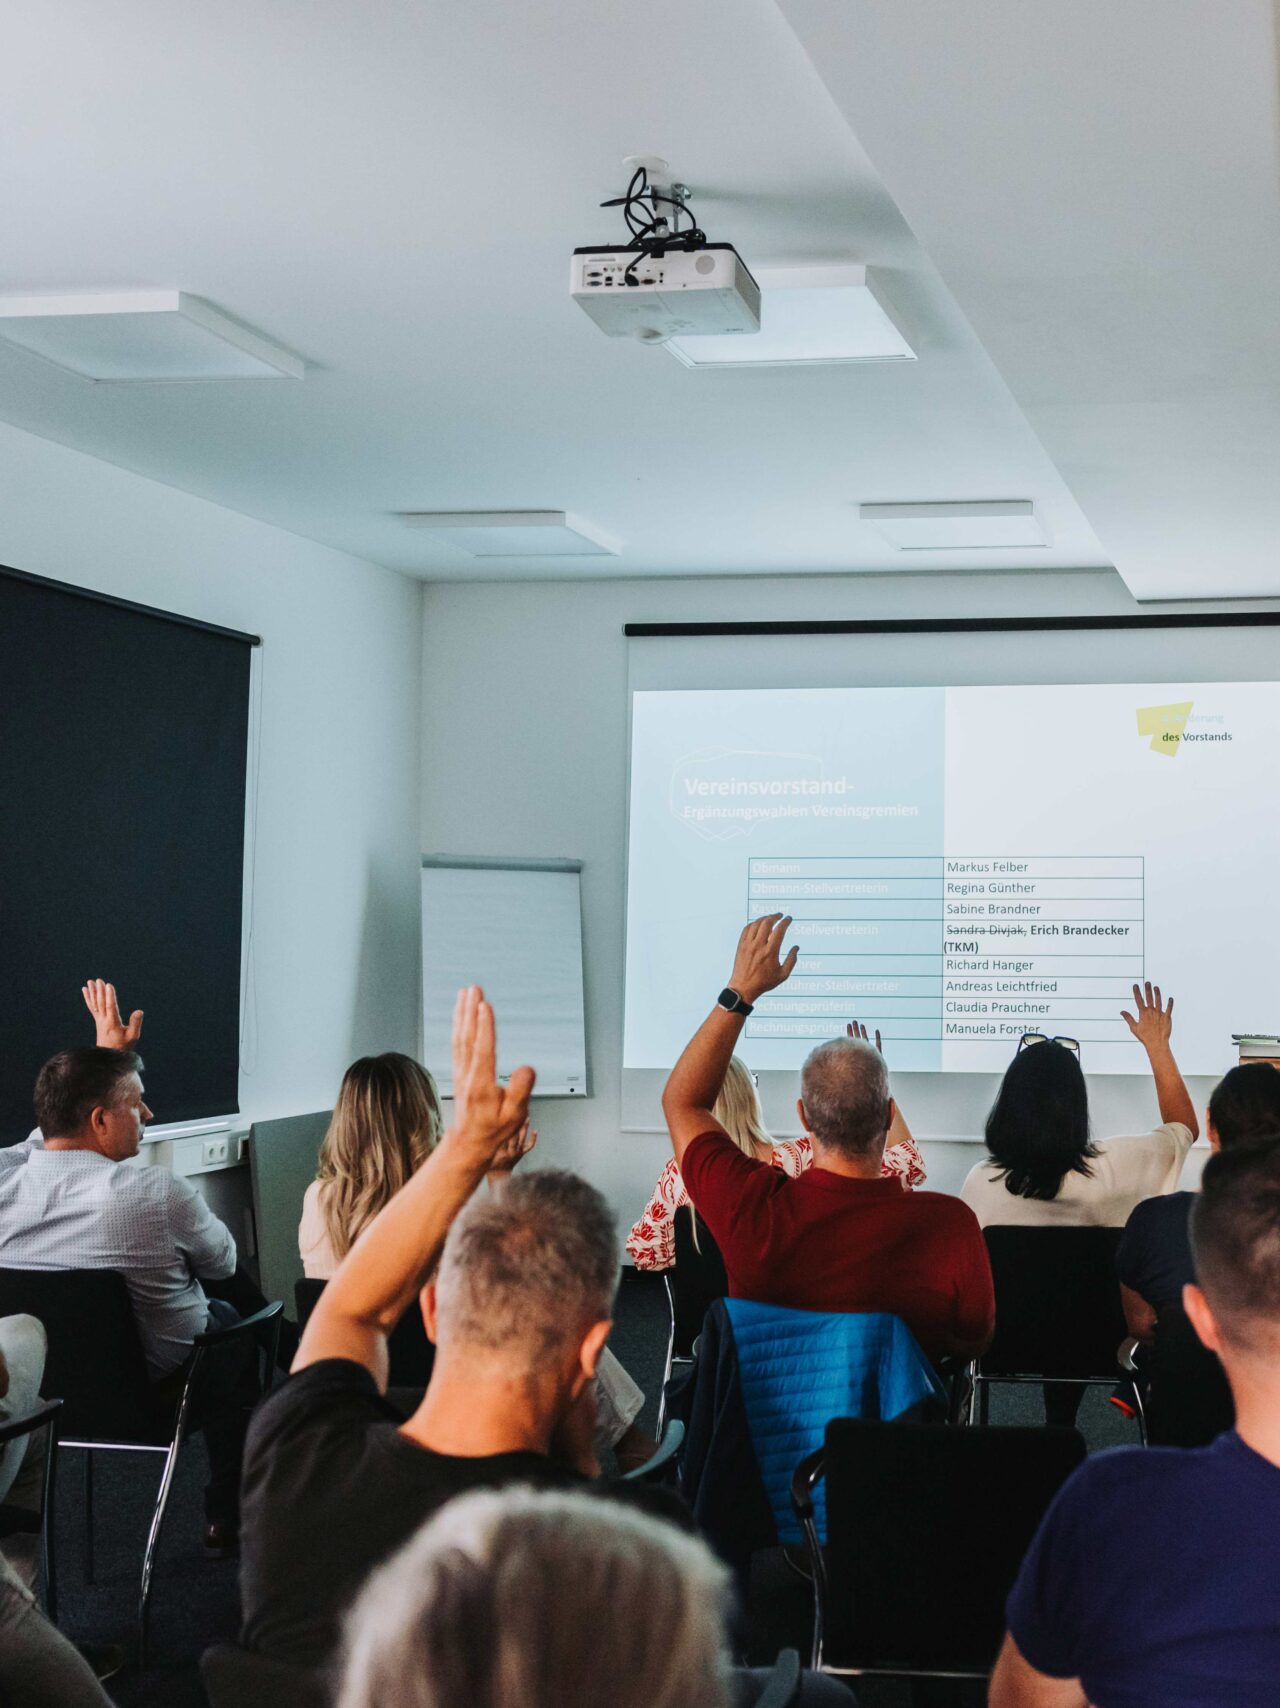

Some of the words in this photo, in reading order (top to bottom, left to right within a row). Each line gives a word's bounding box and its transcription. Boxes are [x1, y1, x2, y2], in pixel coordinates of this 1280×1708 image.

[1162, 732, 1180, 742] des
[1182, 732, 1233, 742] Vorstands
[684, 776, 855, 796] Vereinsvorstand-
[683, 804, 808, 821] Ergänzungswahlen
[812, 803, 918, 820] Vereinsgremien
[752, 863, 801, 873] Obmann
[947, 862, 990, 873] Markus
[993, 862, 1029, 873] Felber
[752, 882, 888, 894] Obmann-Stellvertreterin
[947, 882, 985, 896] Regina
[988, 882, 1036, 893] Günther
[946, 903, 985, 915] Sabine
[988, 903, 1041, 915] Brandner
[946, 925, 986, 935] Sandra
[989, 925, 1028, 938] Divjak,
[1030, 925, 1059, 935] Erich
[1063, 925, 1130, 935] Brandecker
[943, 941, 979, 955] (TKM)
[946, 959, 989, 970] Richard
[992, 959, 1034, 973] Hanger
[946, 981, 993, 991] Andreas
[996, 981, 1057, 992] Leichtfried
[757, 1000, 856, 1013] echnungsprüferin
[946, 1002, 988, 1013] Claudia
[991, 1002, 1051, 1013] Prauchner
[946, 1023, 996, 1034] Manuela
[1000, 1023, 1040, 1034] Forster
